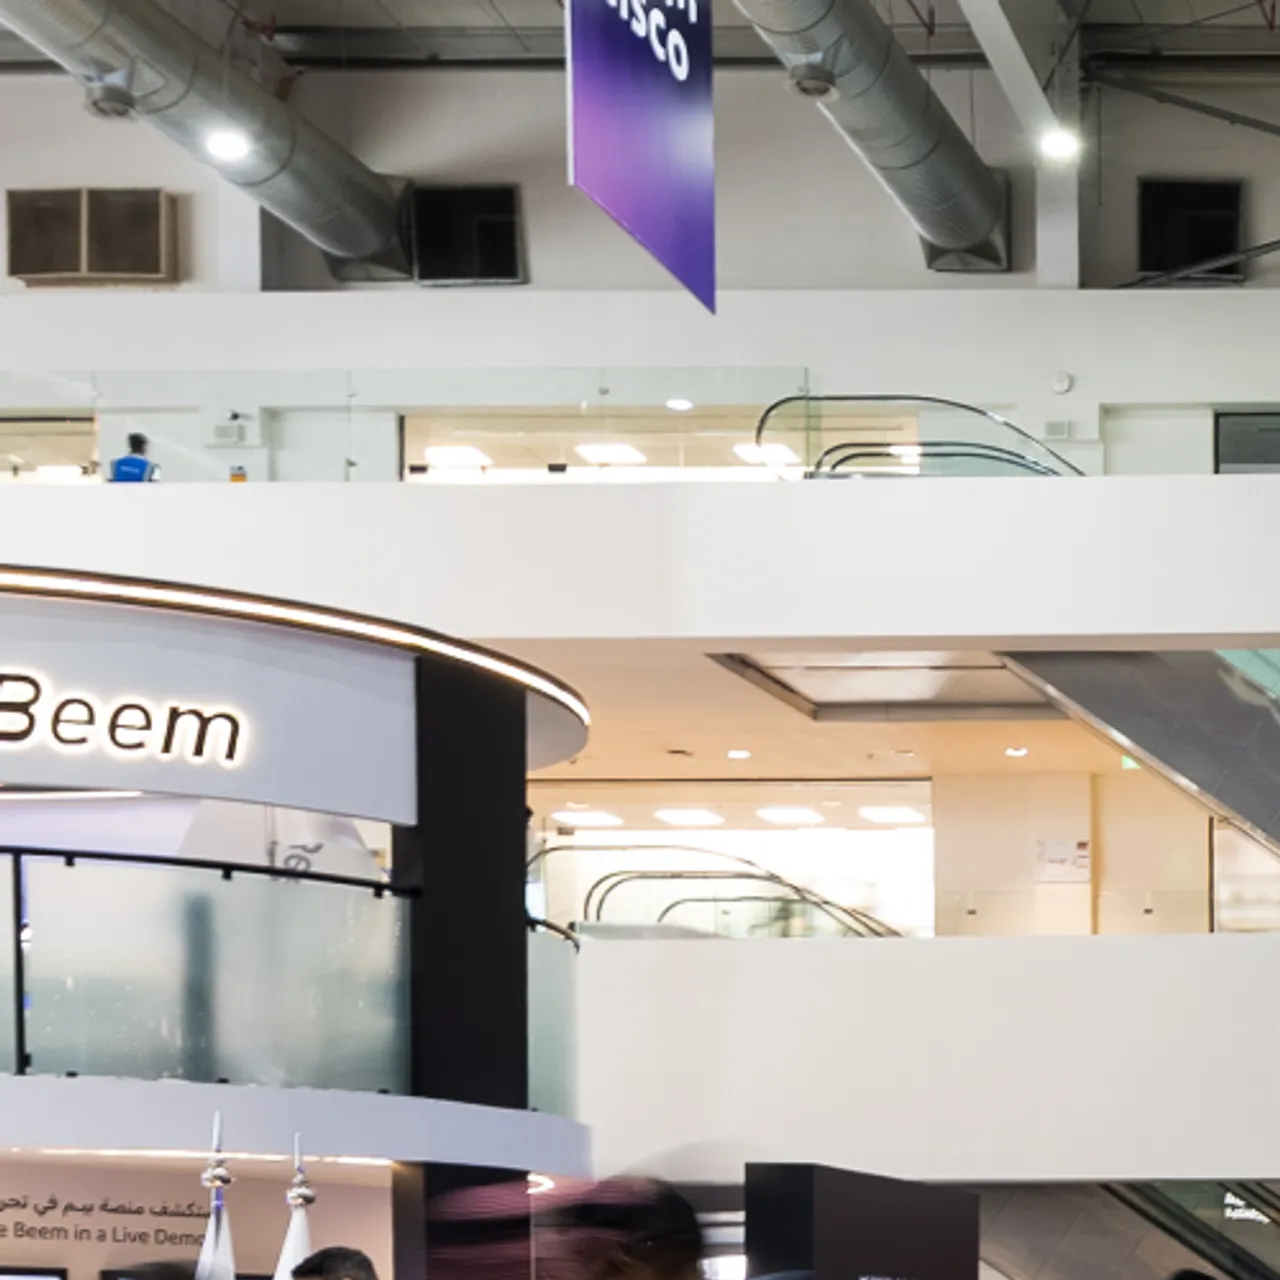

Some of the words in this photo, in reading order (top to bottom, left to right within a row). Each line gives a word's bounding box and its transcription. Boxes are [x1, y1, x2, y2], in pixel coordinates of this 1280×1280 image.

[0, 673, 241, 761] Beem
[13, 1221, 69, 1240] Beem
[74, 1224, 92, 1241] in
[95, 1228, 108, 1243] a
[112, 1227, 151, 1244] Live
